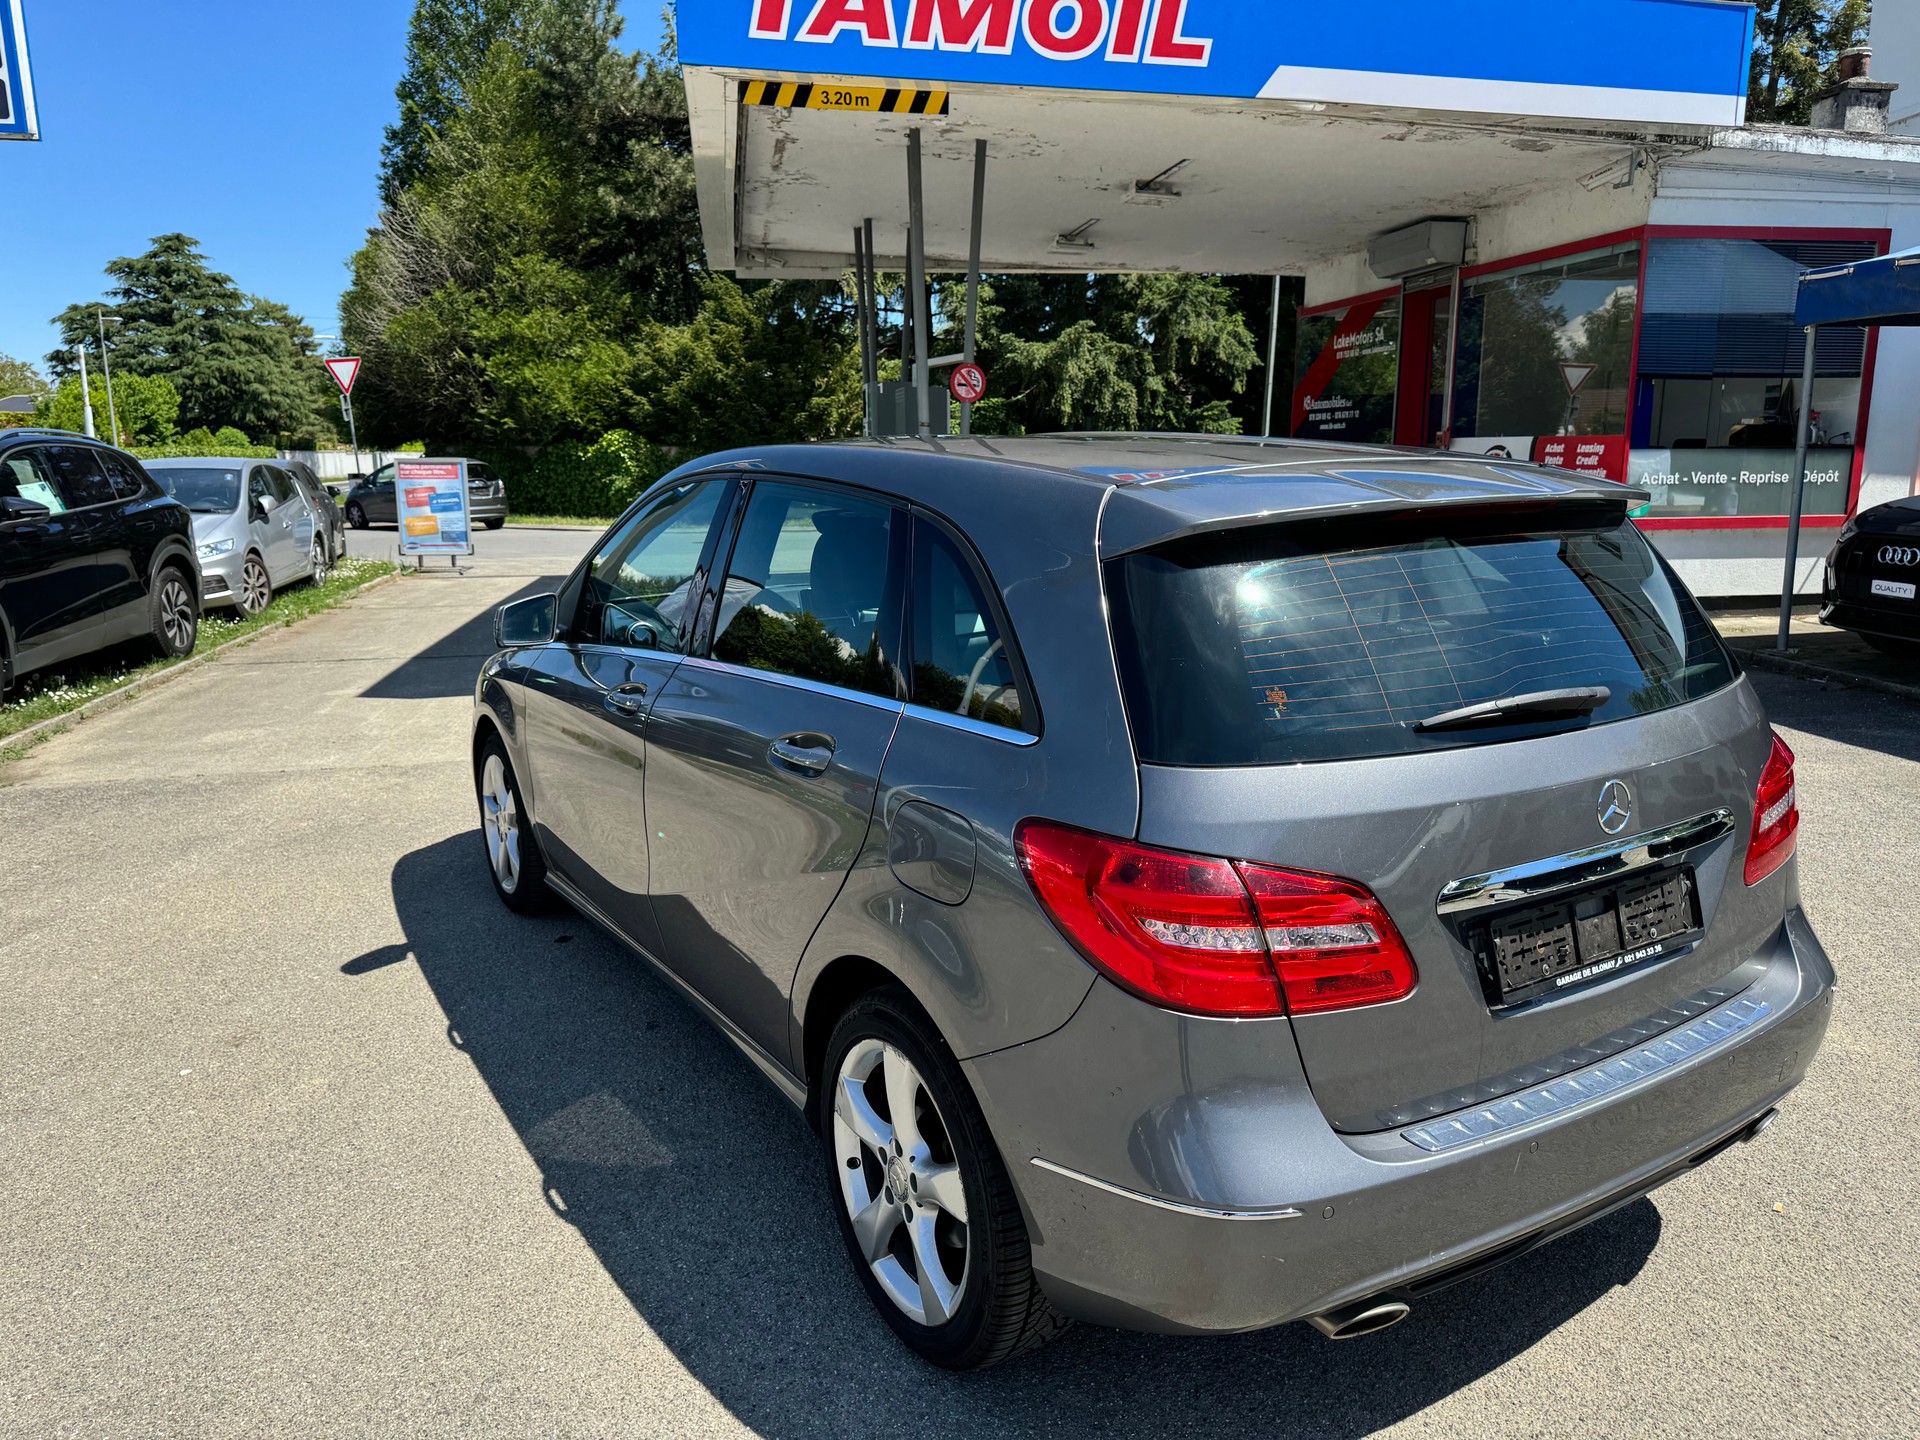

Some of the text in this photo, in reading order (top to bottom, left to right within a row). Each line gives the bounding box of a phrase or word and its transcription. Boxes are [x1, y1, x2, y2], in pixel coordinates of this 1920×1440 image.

[821, 90, 869, 107] 3.20 m
[1333, 331, 1373, 349] LakeMotors
[877, 382, 883, 394] 1
[1545, 443, 1565, 453] Achat
[1576, 443, 1605, 455] Leasing
[1544, 455, 1564, 465] Vente
[1576, 455, 1599, 465] Credit
[1640, 471, 1680, 485] Achat
[1691, 471, 1728, 484] Vente
[1739, 470, 1789, 486] Reprise
[1875, 584, 1908, 594] QUALITY
[1556, 971, 1582, 986] GARAGE
[1582, 968, 1592, 978] DE
[1592, 960, 1616, 975] BLONAY
[1624, 954, 1635, 964] 021
[1635, 949, 1646, 959] 943
[1647, 947, 1655, 956] 33
